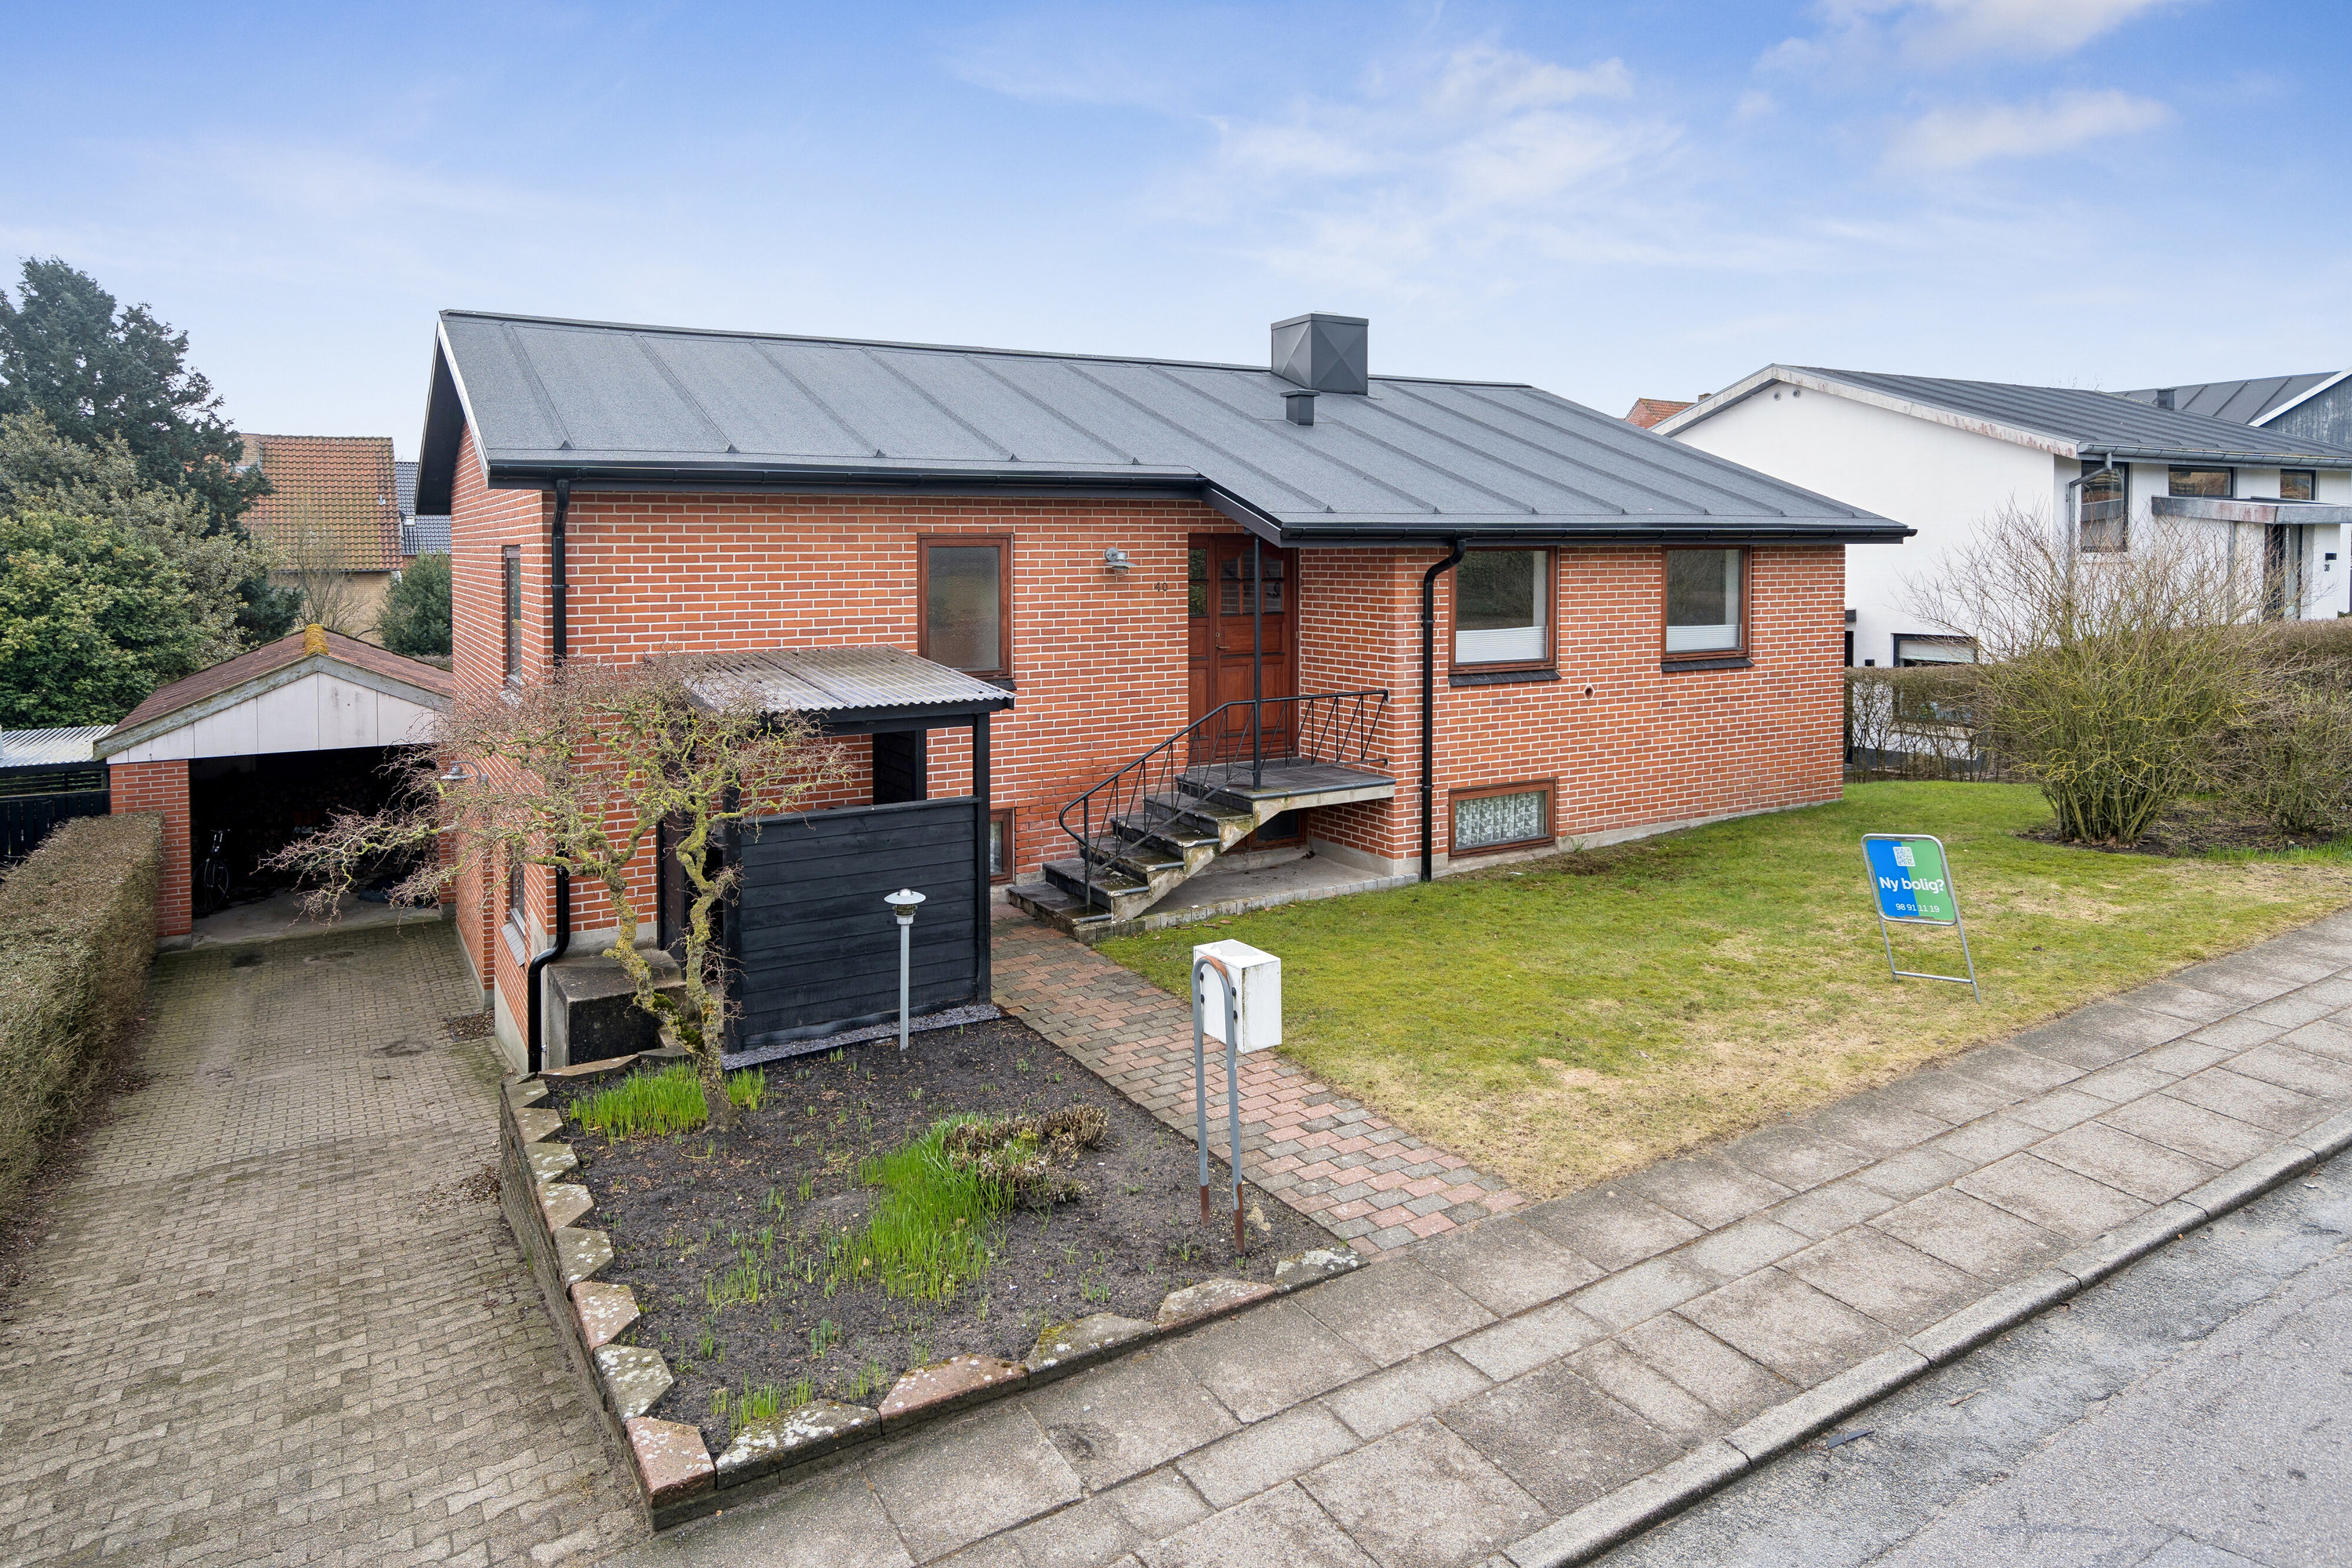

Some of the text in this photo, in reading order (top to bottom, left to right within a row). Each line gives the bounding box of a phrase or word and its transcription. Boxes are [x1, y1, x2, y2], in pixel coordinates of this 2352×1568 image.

[1155, 582, 1168, 591] 40
[1878, 877, 1944, 894] Ny bolig?
